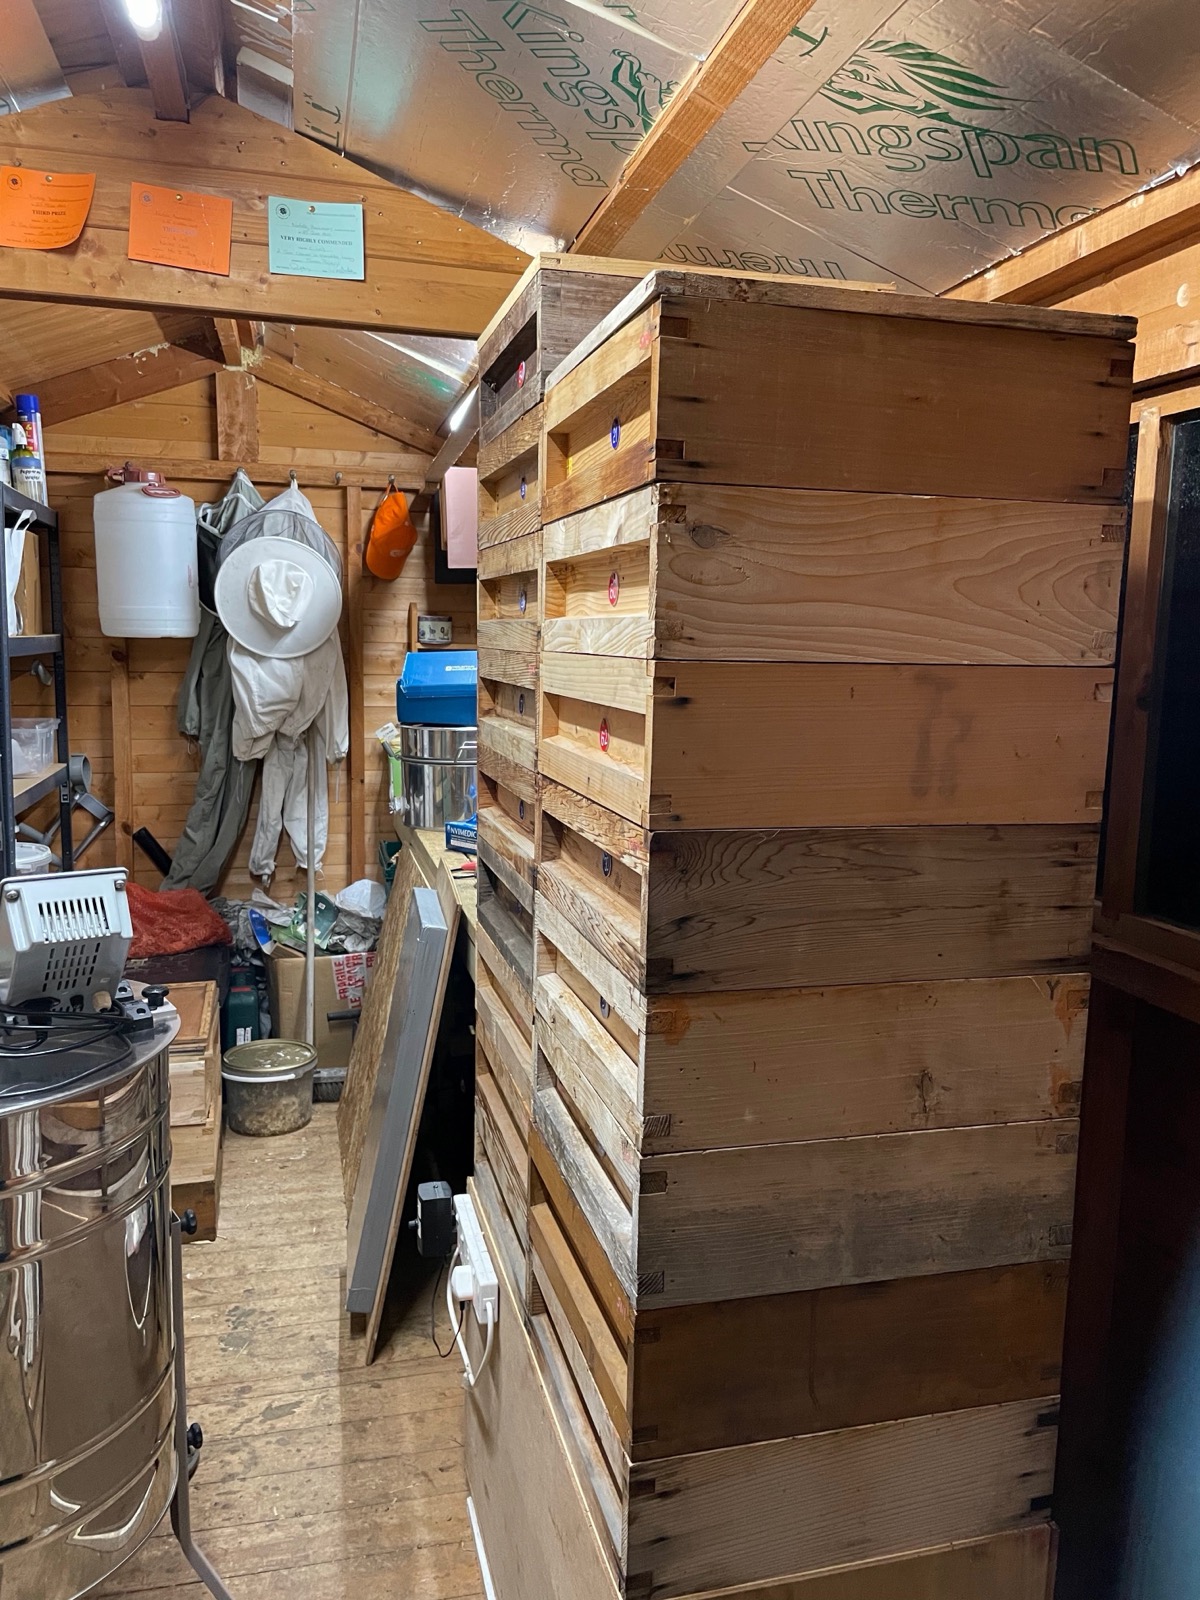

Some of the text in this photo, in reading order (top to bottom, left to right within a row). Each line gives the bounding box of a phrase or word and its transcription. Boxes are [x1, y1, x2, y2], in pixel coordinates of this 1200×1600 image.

[418, 9, 609, 188] Therma
[317, 238, 353, 246] COMMENDED
[334, 960, 348, 999] FRAGILE
